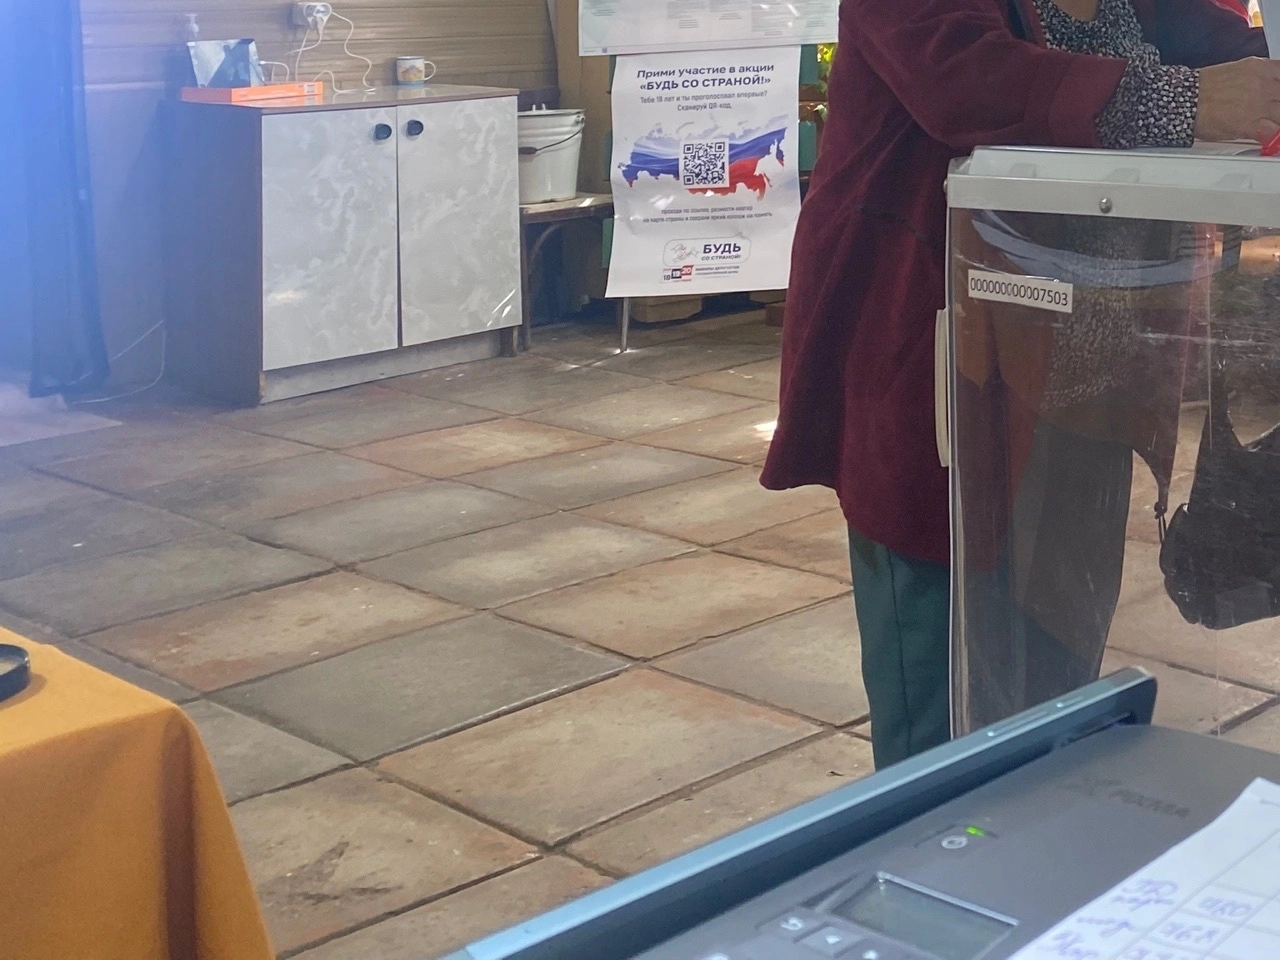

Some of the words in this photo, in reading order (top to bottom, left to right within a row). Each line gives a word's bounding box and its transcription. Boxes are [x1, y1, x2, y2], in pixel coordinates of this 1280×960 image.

[637, 70, 676, 79] Прими
[678, 66, 726, 77] участие
[728, 65, 736, 73] в
[738, 65, 775, 73] акции
[640, 80, 679, 91] «БУДЬ
[681, 79, 699, 89] СО
[702, 75, 771, 87] СТРАНОЙ!»
[640, 96, 655, 104] Тебе
[691, 93, 735, 102] проголосовал
[677, 103, 708, 112] Сканируй
[703, 243, 742, 254] БУДЬ
[970, 277, 1068, 306] 000000000007503
